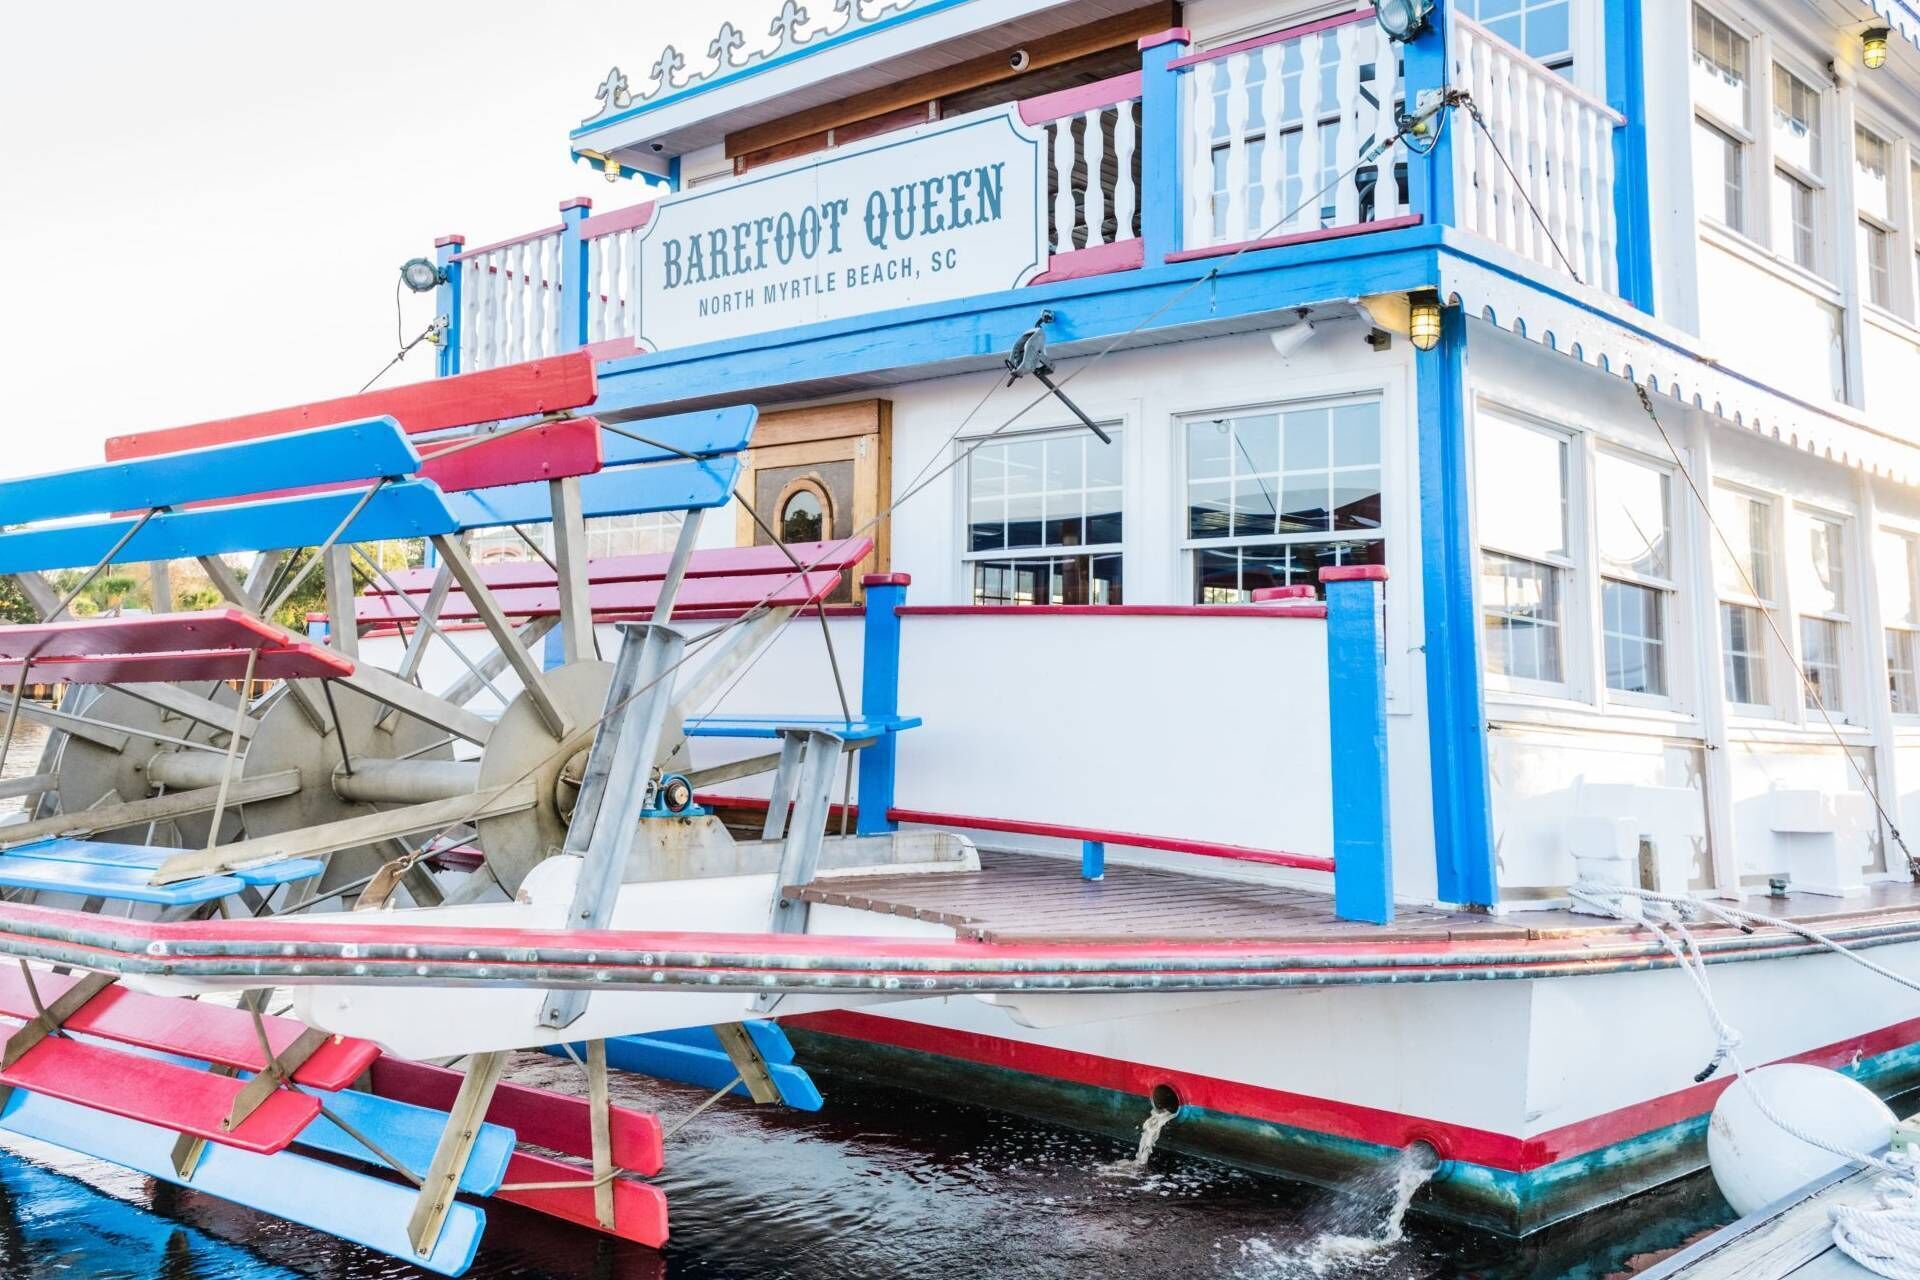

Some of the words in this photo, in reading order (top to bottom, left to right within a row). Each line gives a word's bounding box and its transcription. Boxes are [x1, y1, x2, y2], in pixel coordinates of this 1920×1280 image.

[662, 198, 849, 290] BAREFOOT
[863, 161, 1006, 251] QUEEN
[699, 288, 754, 317] NORTH
[764, 271, 836, 304] MYRTLE
[846, 256, 921, 289] BEACH,
[931, 248, 957, 273] SC
